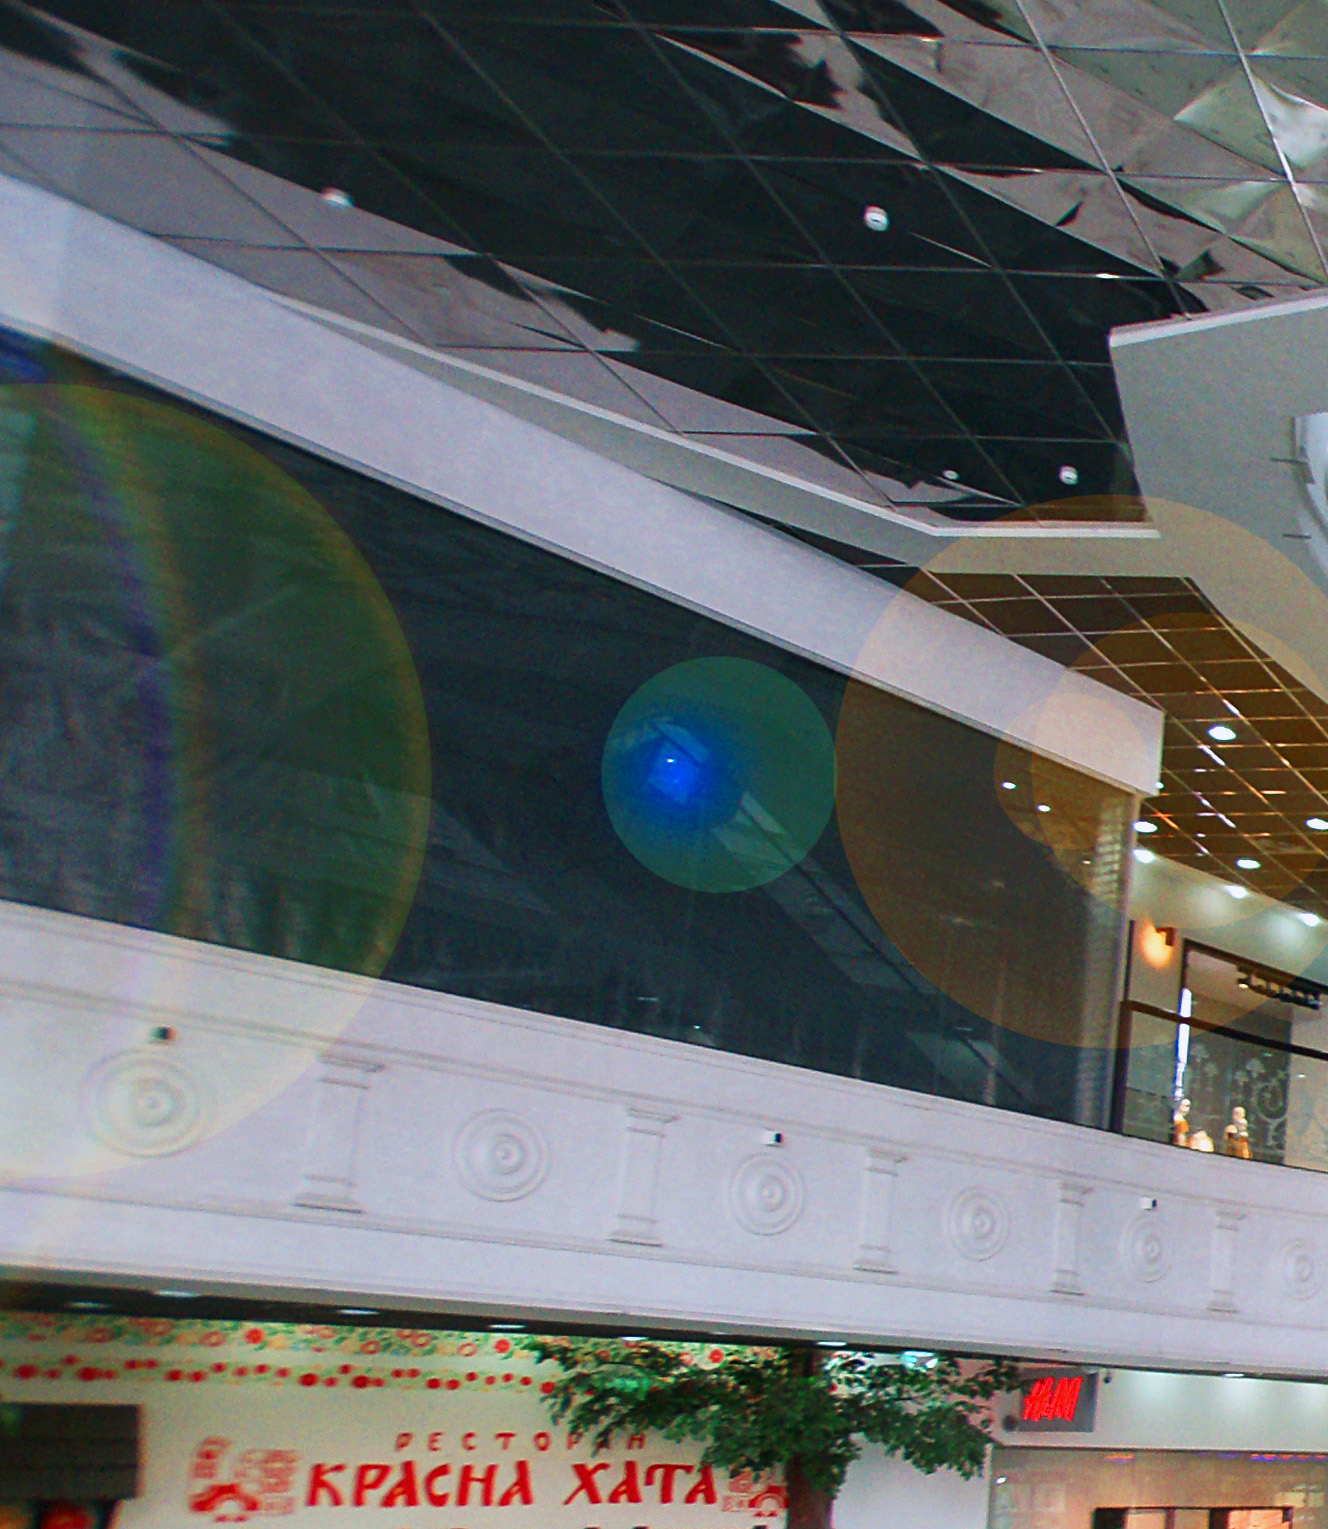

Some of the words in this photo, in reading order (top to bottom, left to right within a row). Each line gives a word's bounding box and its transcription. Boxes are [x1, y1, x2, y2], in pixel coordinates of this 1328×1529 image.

[1022, 1376, 1083, 1423] H&M
[305, 1459, 534, 1508] КРАСНА
[562, 1459, 718, 1505] ХАТА
